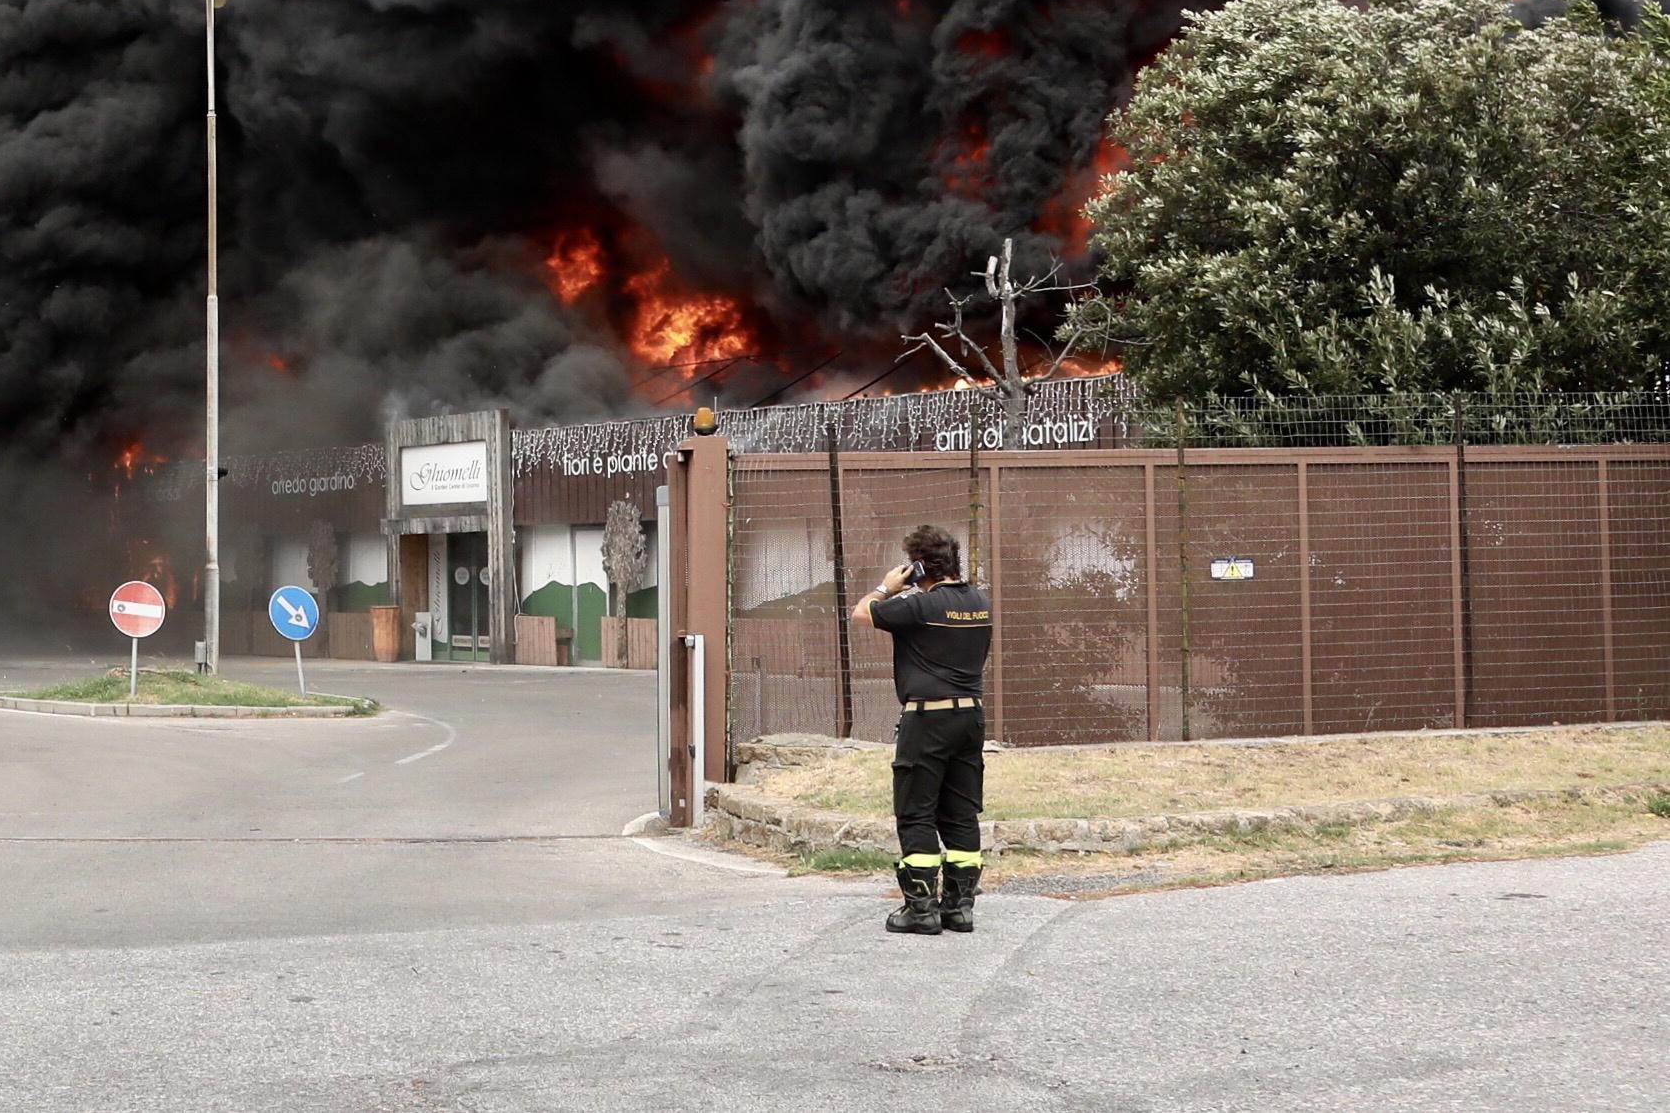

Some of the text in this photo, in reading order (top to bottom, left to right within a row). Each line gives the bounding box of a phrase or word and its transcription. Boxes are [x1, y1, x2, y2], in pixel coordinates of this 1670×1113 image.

[607, 449, 658, 479] piante
[271, 473, 354, 497] arredo giardino
